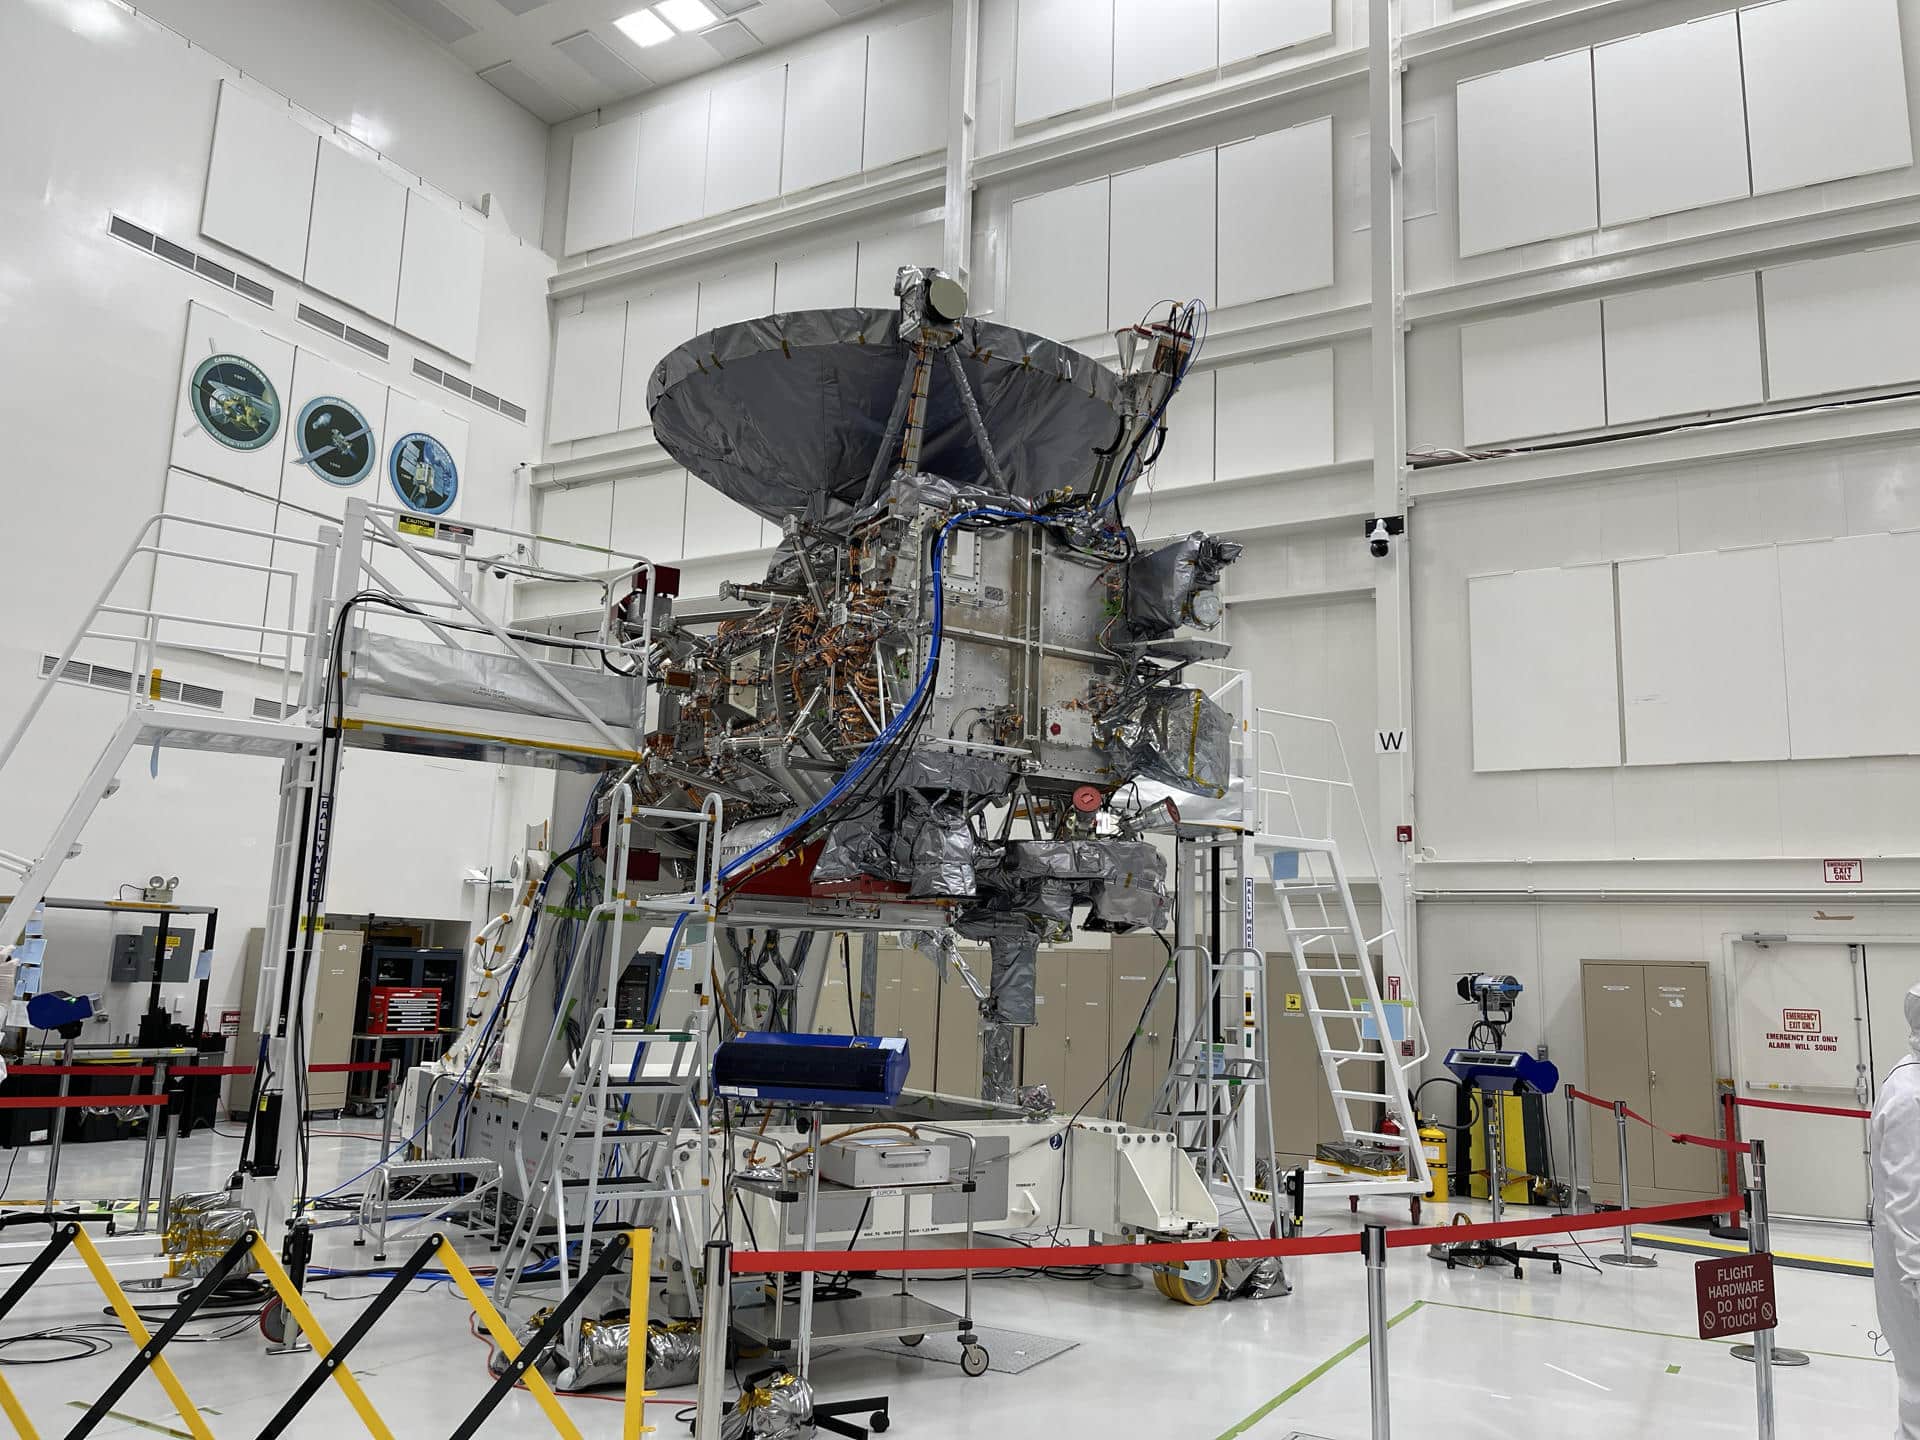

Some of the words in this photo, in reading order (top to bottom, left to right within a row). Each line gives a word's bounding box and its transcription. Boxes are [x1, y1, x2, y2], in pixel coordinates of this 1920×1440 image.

[1379, 731, 1403, 751] W
[1785, 1012, 1818, 1021] EMERGENCY
[1789, 1021, 1801, 1029] EXIT
[1802, 1021, 1815, 1030] ONLY
[1766, 1033, 1804, 1041] EMERGENCY
[1815, 1044, 1837, 1052] SOUND
[1717, 1265, 1754, 1281] FLIGHT
[1708, 1280, 1765, 1299] HARDWARE
[1717, 1300, 1733, 1314] DO
[1737, 1296, 1758, 1311] NOT
[1720, 1311, 1757, 1329] TOUCH
